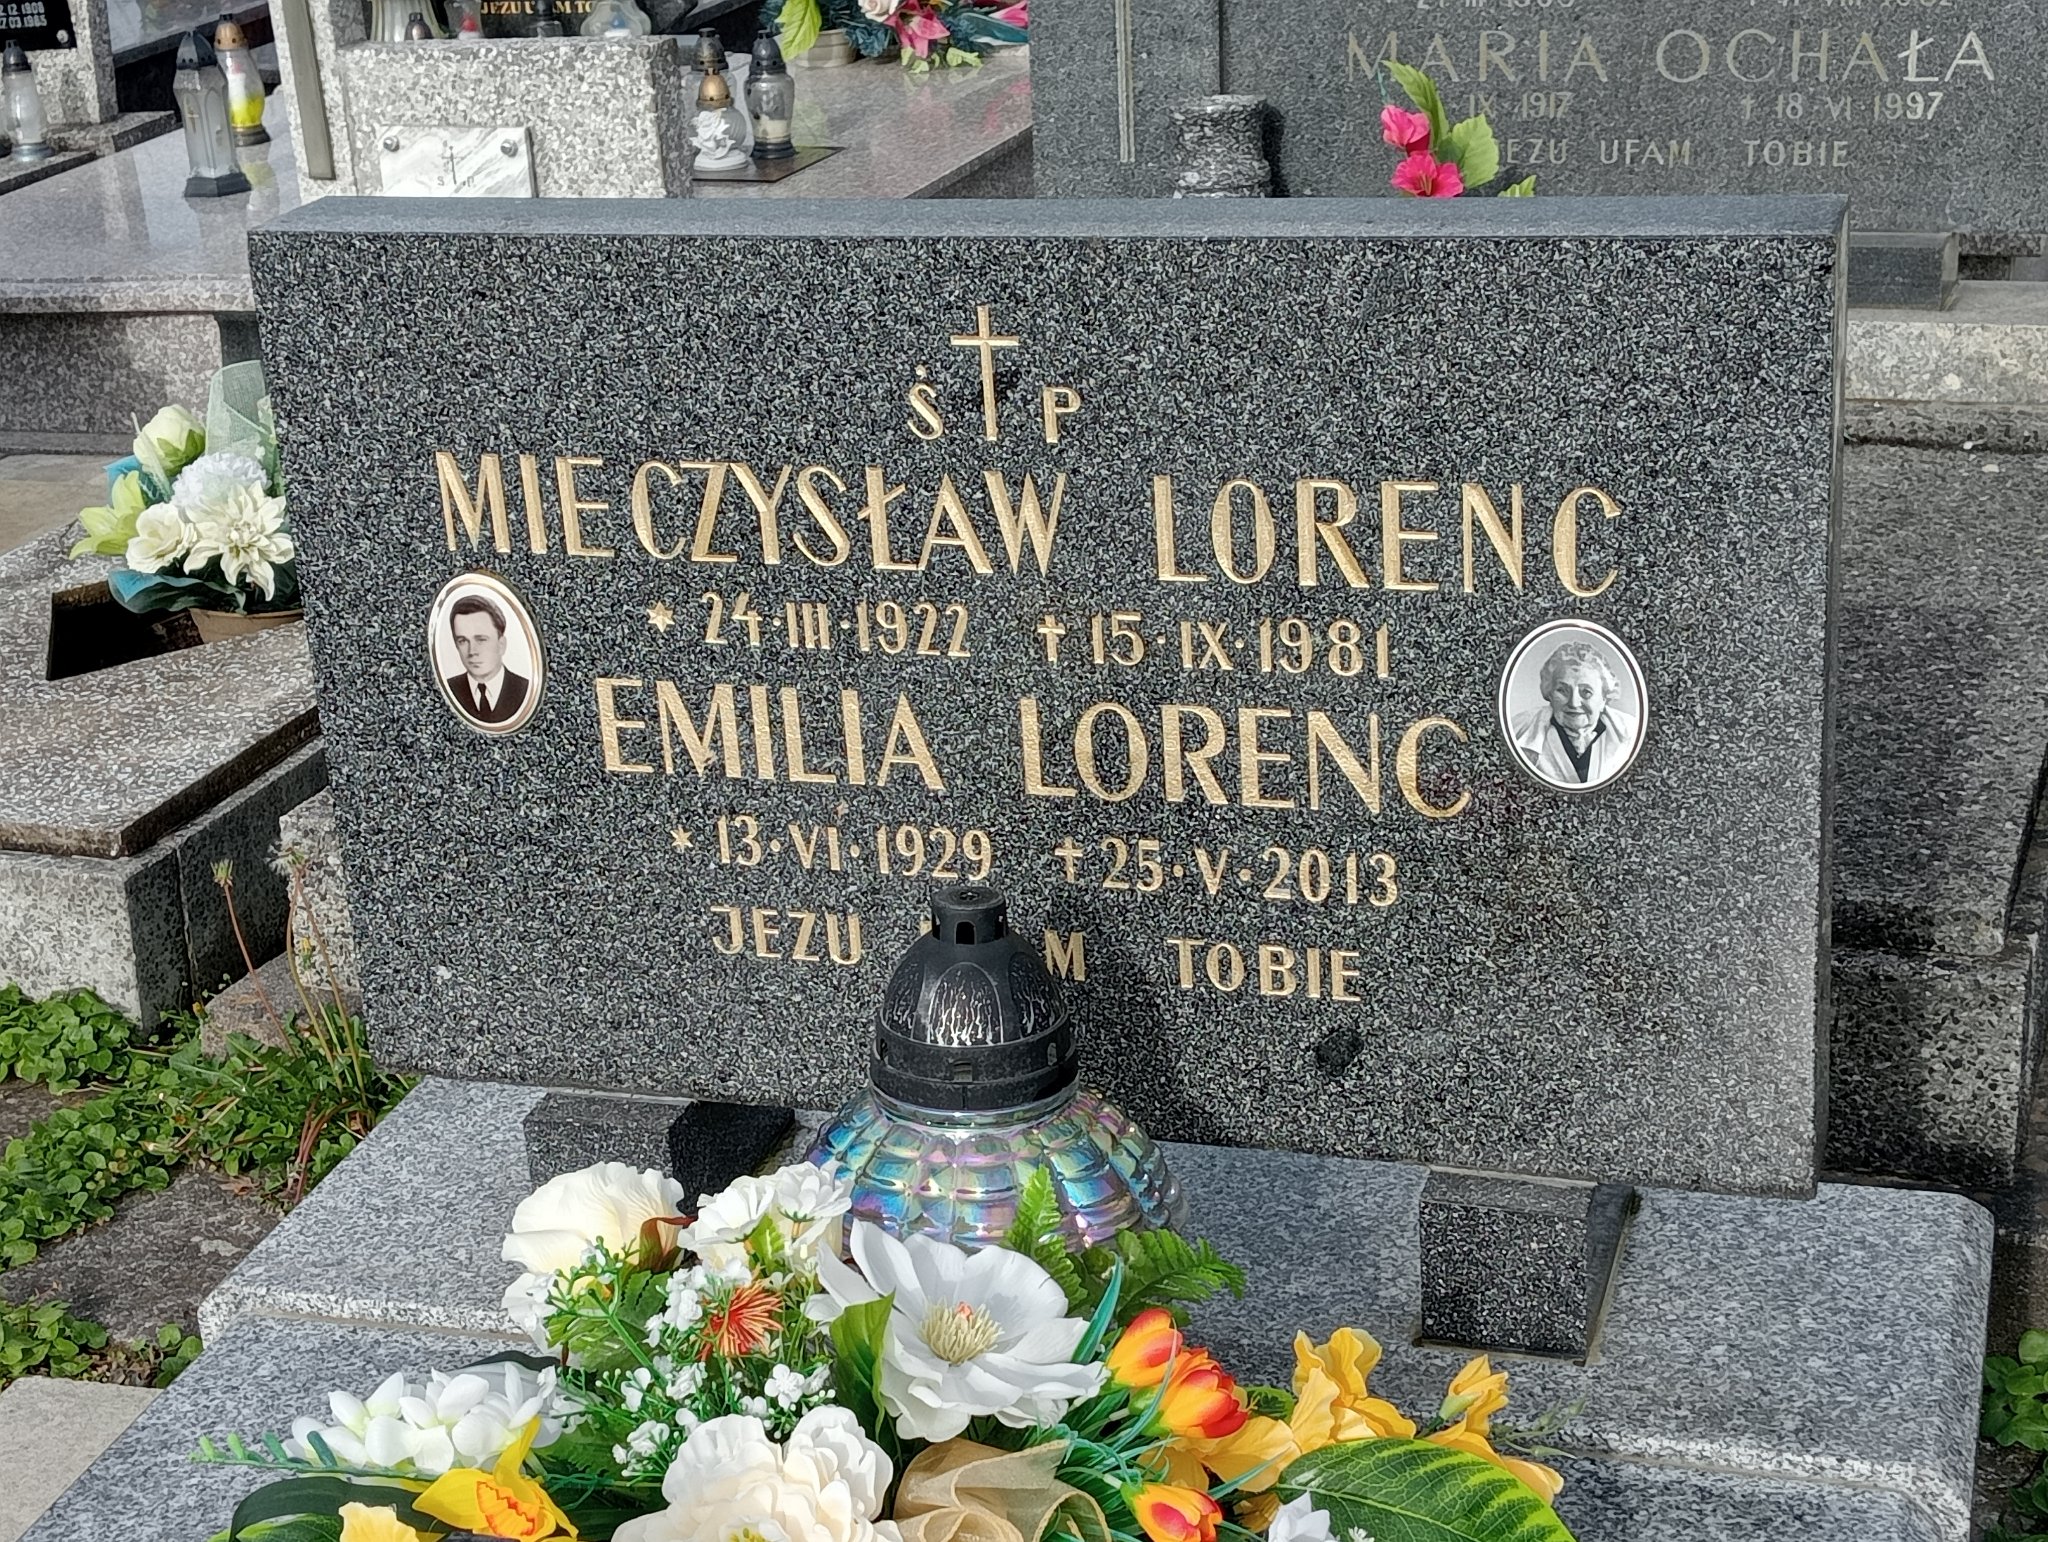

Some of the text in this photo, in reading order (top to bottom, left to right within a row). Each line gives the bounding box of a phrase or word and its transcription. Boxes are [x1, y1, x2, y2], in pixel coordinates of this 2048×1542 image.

[480, 1, 521, 14] JEZU
[1348, 29, 1995, 82] MARIA OCHAŁA
[1521, 91, 1576, 120] 1917
[1775, 92, 1803, 120] 18
[1874, 92, 1943, 121] 1997
[1506, 138, 1850, 168] EZU UFAM TOBIE
[1043, 386, 1081, 444] P
[435, 451, 1622, 597] MIECZYSŁAW LORENC
[595, 677, 1473, 819] EMILIA LORENC
[710, 906, 863, 965] JEZU
[1167, 937, 1362, 1002] TOBIE
